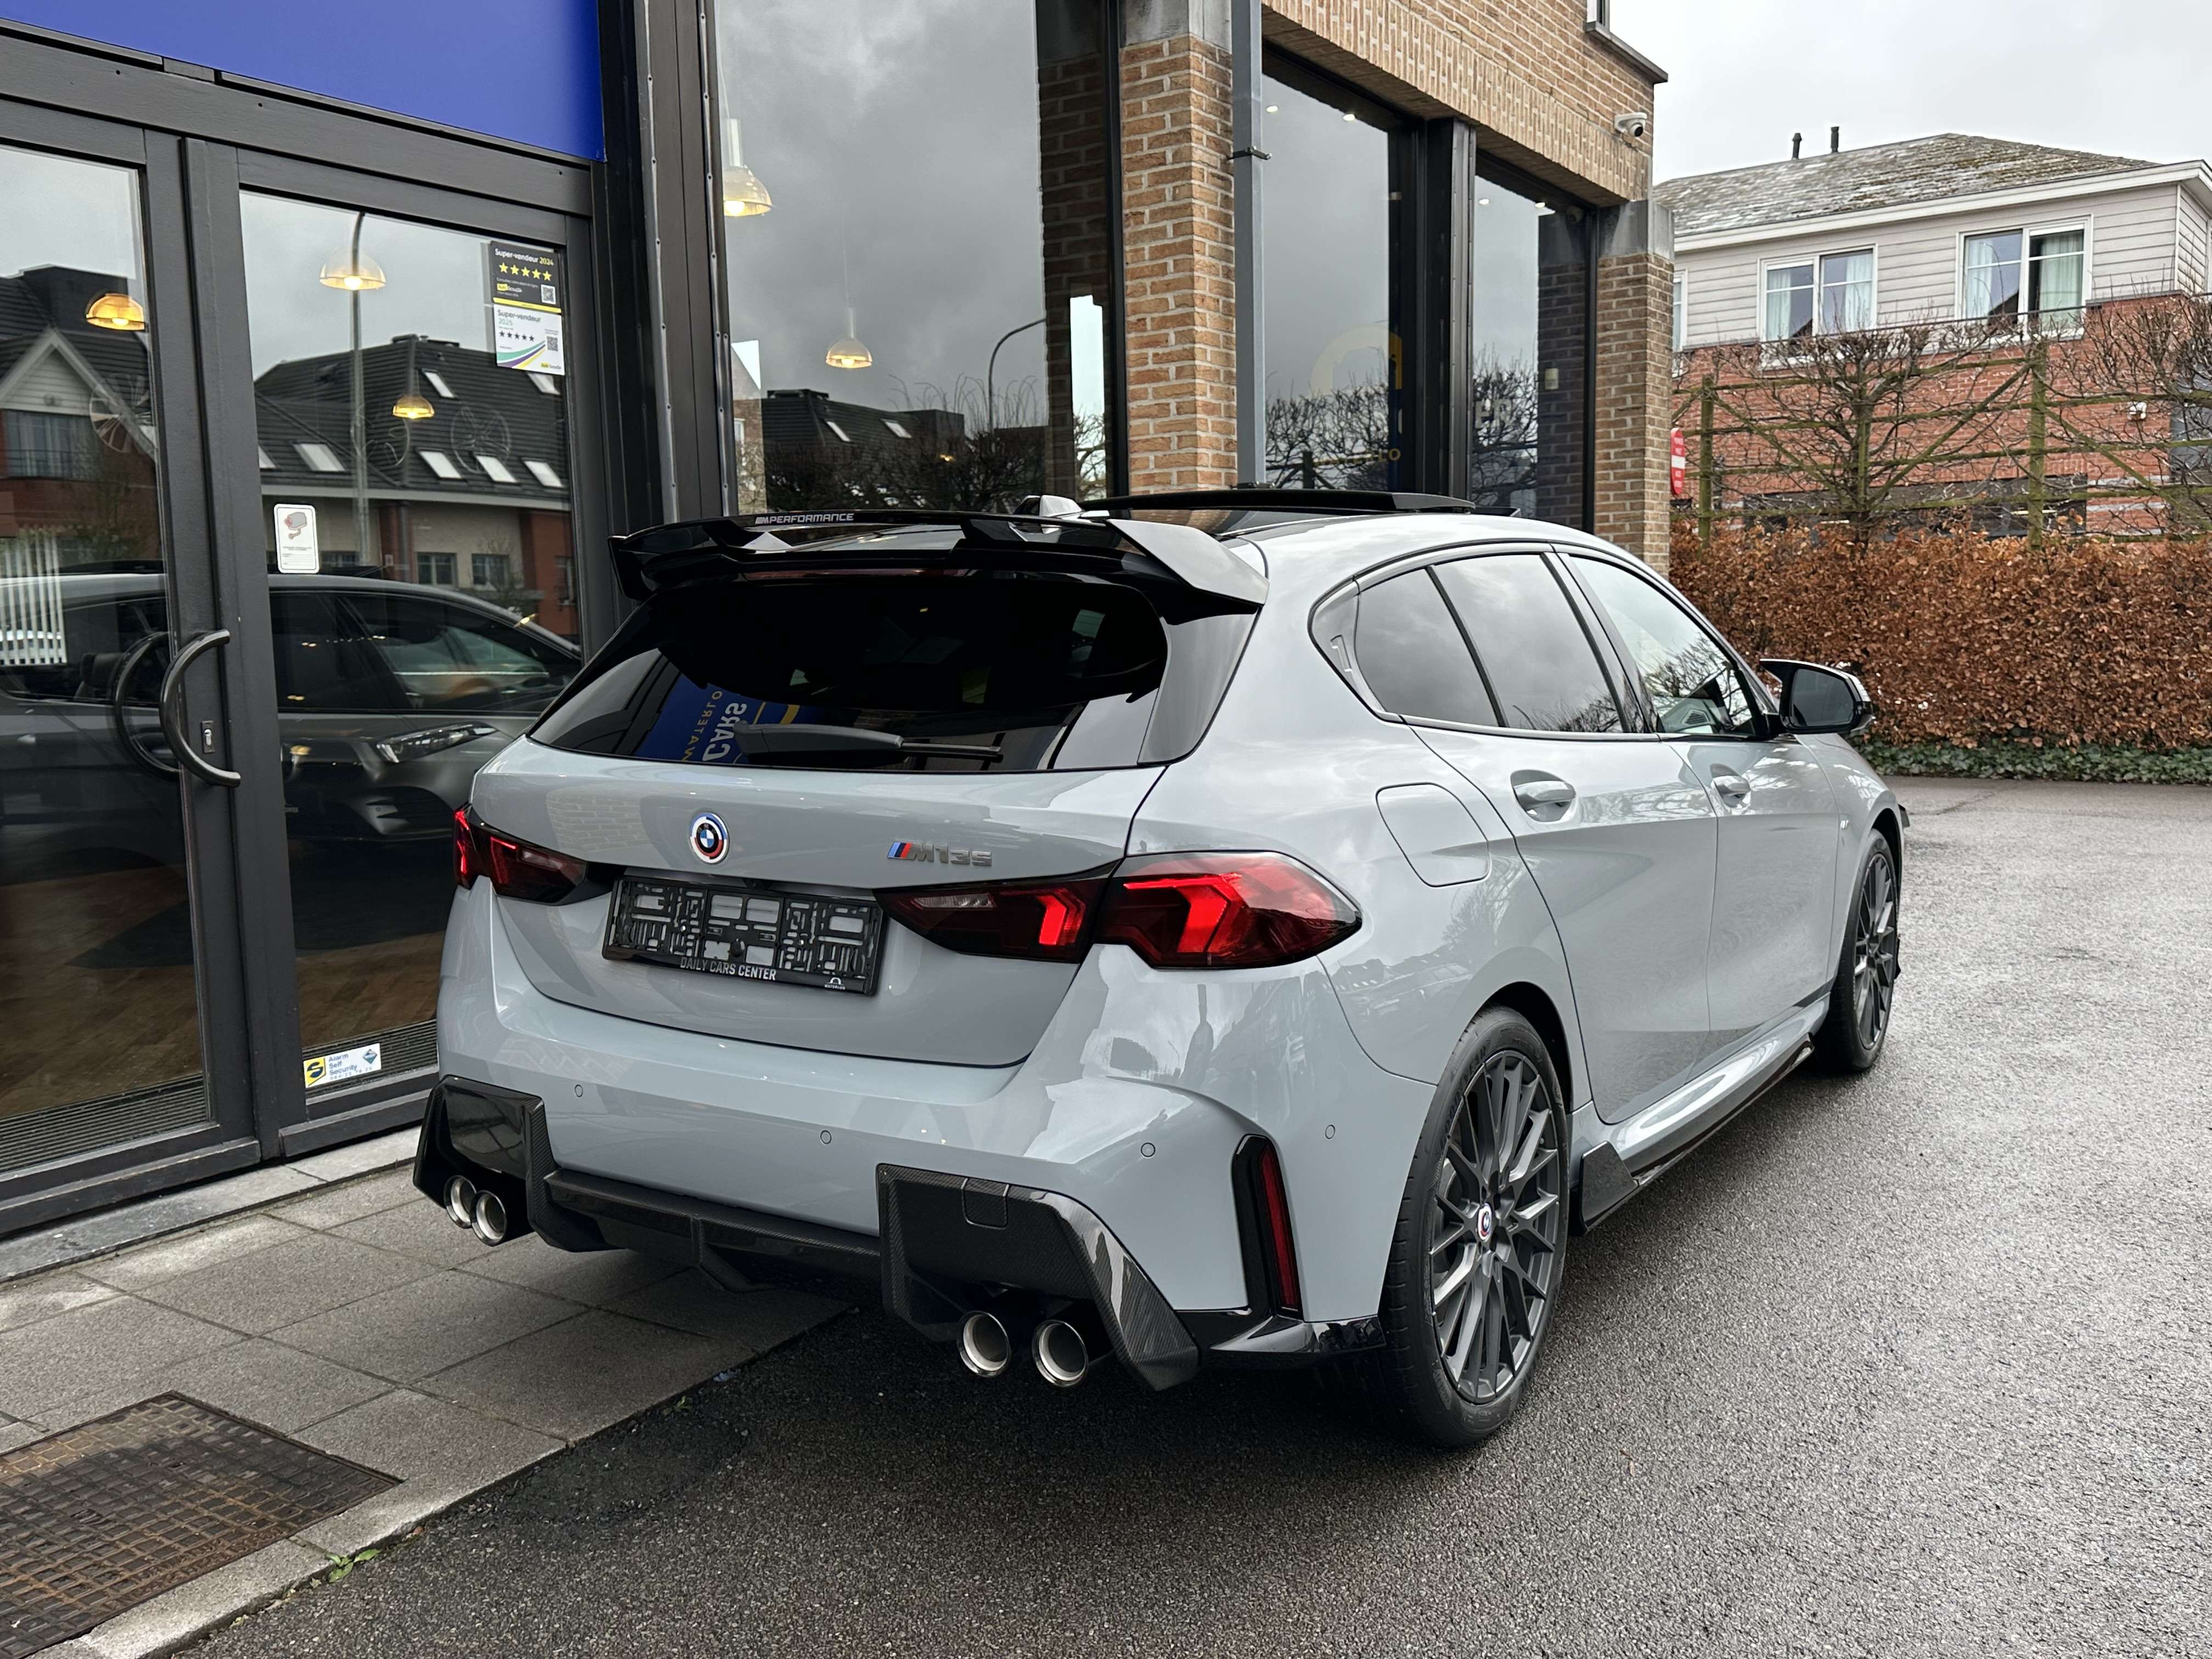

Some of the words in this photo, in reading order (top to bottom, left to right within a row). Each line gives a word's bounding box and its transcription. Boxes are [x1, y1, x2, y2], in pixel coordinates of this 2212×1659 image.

[495, 249, 538, 263] Super-vendeur
[539, 257, 554, 266] 2024
[498, 309, 541, 323] Super-vendeur
[498, 318, 514, 326] 2025
[769, 513, 855, 524] PERFORMANCE
[680, 956, 708, 972] DAILY
[709, 961, 736, 976] CARS
[738, 964, 777, 981] CENTER
[329, 1053, 349, 1063] Alarm
[329, 1060, 342, 1070] Self
[330, 1065, 357, 1076] Security
